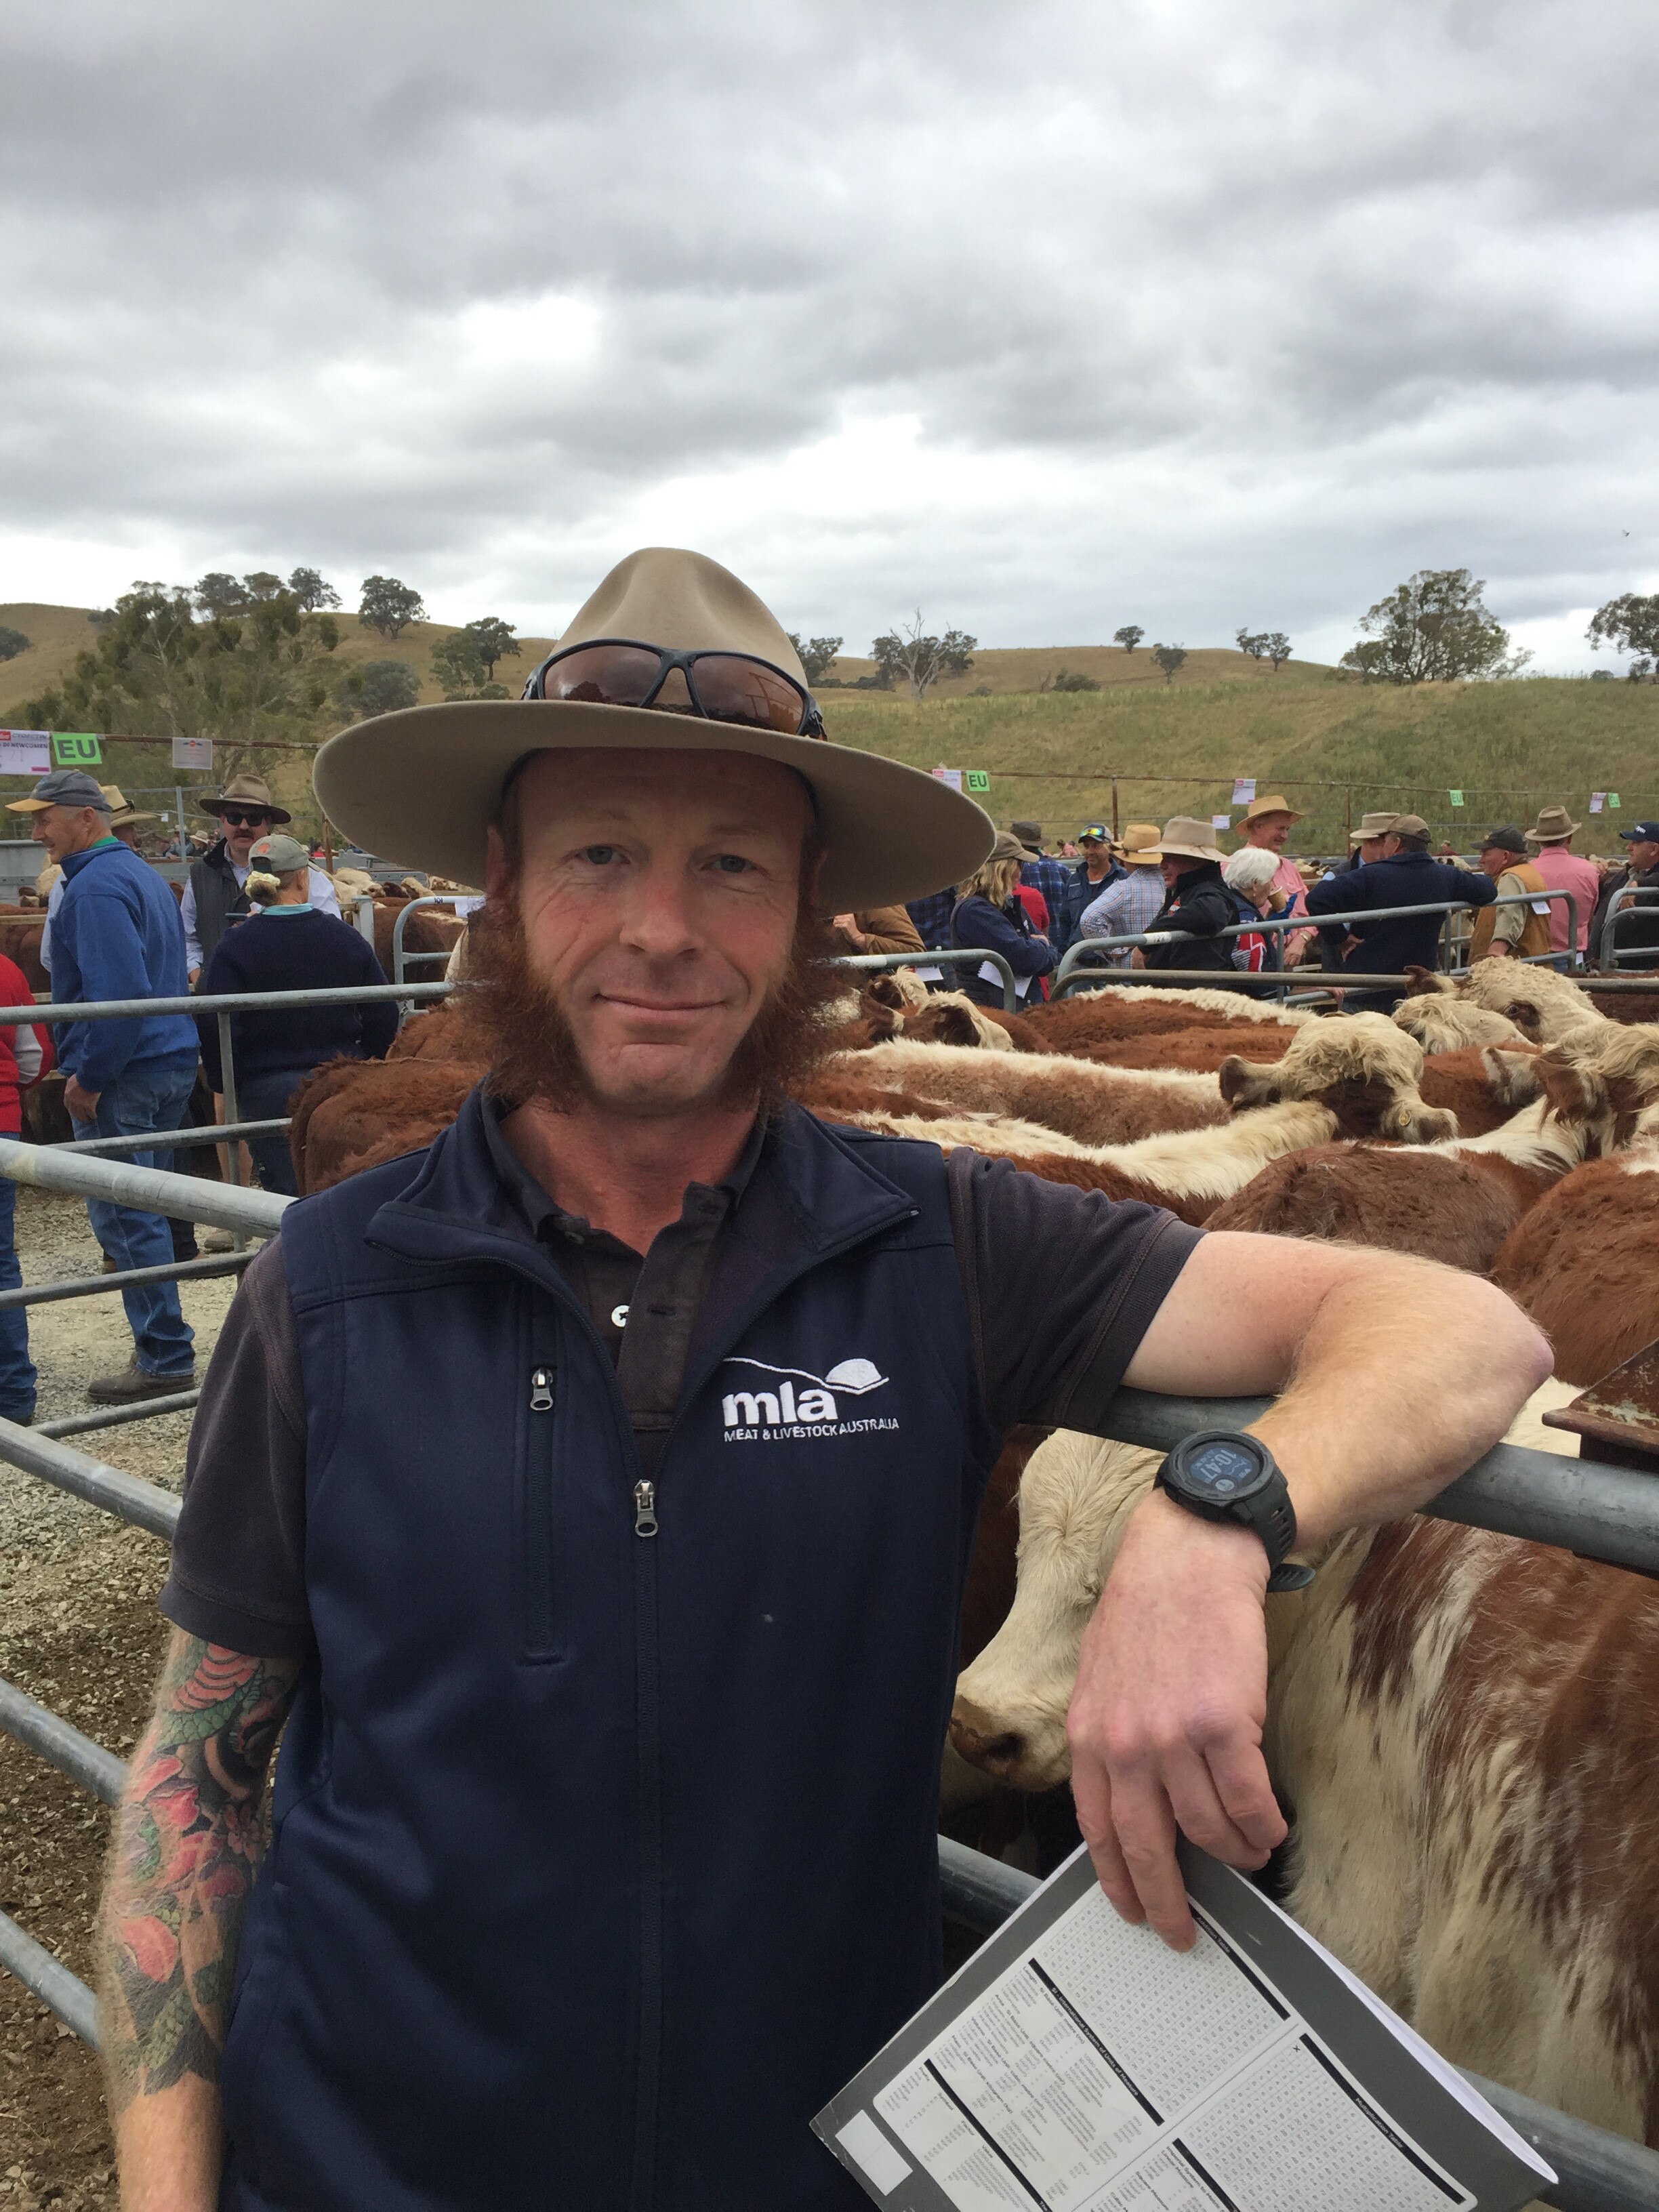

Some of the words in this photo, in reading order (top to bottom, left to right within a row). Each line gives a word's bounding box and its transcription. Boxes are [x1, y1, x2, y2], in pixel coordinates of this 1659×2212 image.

[57, 739, 96, 758] EU
[968, 775, 987, 787] EU
[722, 1380, 838, 1427] mla
[724, 1429, 758, 1442] MEAT
[762, 1429, 771, 1440] &
[773, 1425, 838, 1440] LIVESTOCK
[839, 1418, 900, 1435] AUSTRALIA
[1200, 1449, 1237, 1480] 10:47
[1216, 1938, 1230, 1953] Table
[994, 1994, 1005, 2007] Area
[1009, 2015, 1021, 2029] Base
[1028, 2040, 1044, 2058] square
[1022, 1965, 1038, 1985] Length
[1042, 1992, 1054, 2007] Base
[1063, 2018, 1077, 2034] metre
[1075, 2033, 1085, 2045] (m)
[970, 2015, 985, 2036] Volume
[990, 2044, 1002, 2058] Base
[1058, 1996, 1086, 2029] International
[1083, 2027, 1100, 2047] System
[1103, 2052, 1116, 2068] Units
[1119, 2072, 1139, 2096] Measure
[951, 2034, 962, 2049] Mass
[966, 2056, 977, 2070] Base
[985, 2081, 1004, 2104] kilogram
[937, 2091, 954, 2111] Symbol
[960, 2119, 975, 2136] Factor
[1355, 2097, 1389, 2137] Multiplication
[1388, 2132, 1403, 2148] Table
[1160, 2149, 1176, 2167] Linear
[1174, 2166, 1194, 2189] Measure
[1165, 2145, 1185, 2167] Imperial
[1183, 2166, 1201, 2188] System
[1205, 2192, 1221, 2210] Metric
[1039, 2200, 1048, 2212] The
[1109, 2191, 1123, 2207] Cubic
[1134, 2170, 1151, 2190] Square
[1150, 2188, 1170, 2212] Measure
